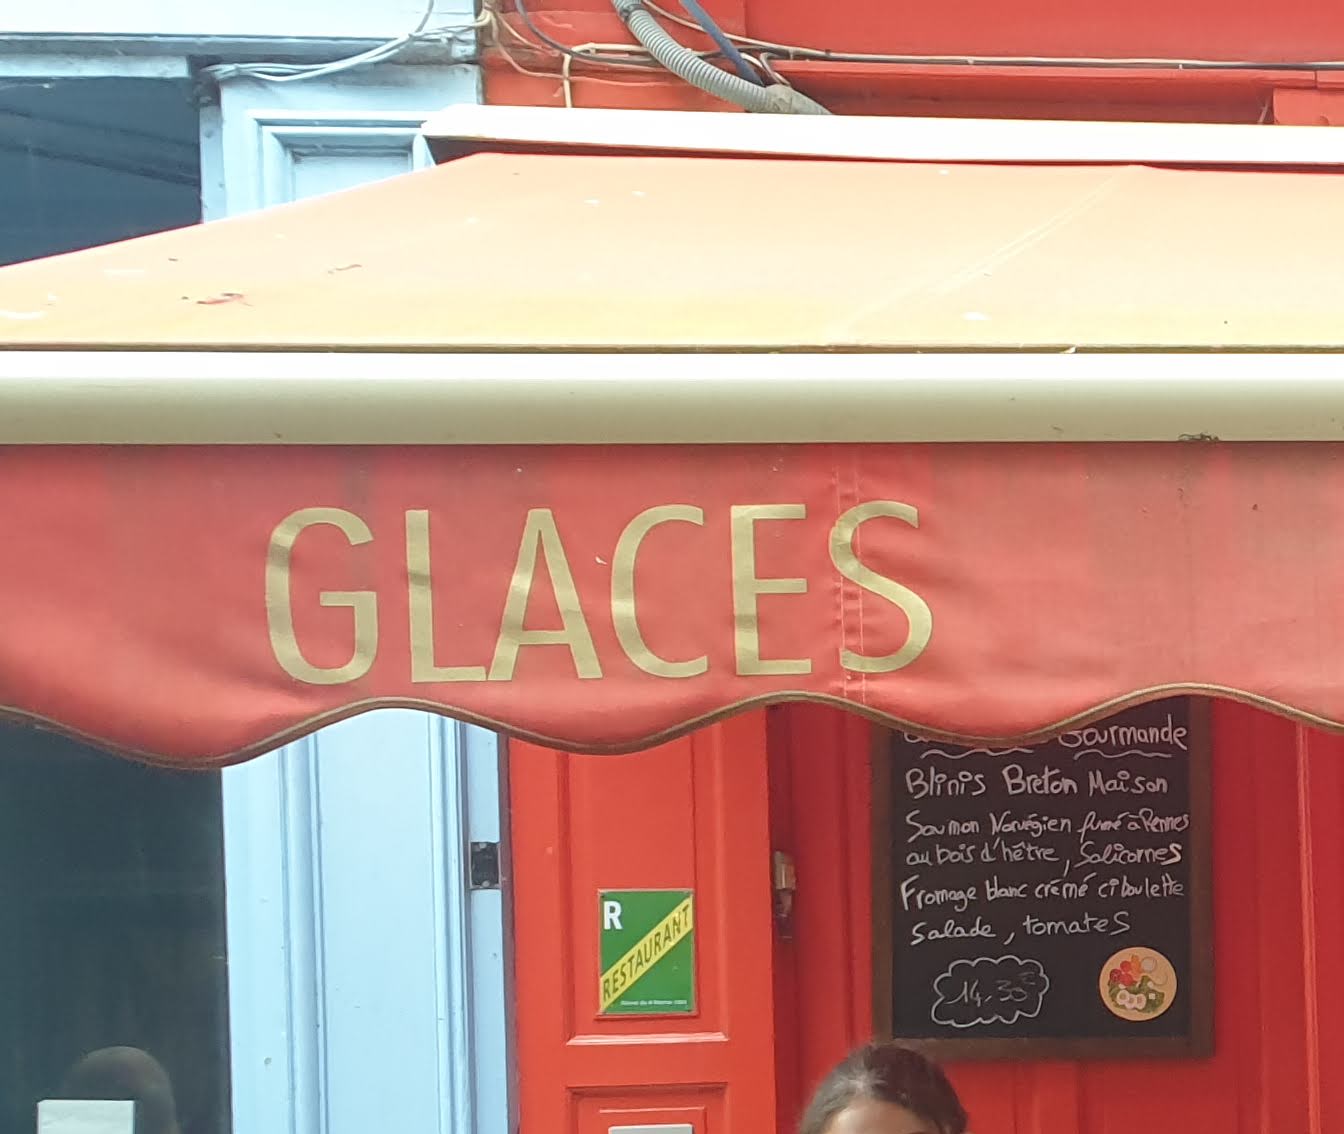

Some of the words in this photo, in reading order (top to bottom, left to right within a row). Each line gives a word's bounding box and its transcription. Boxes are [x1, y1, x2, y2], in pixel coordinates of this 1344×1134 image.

[264, 501, 933, 685] GLACES
[905, 765, 987, 799] Blinis
[1001, 764, 1078, 796] Breton
[1088, 768, 1169, 798] Maison
[906, 849, 934, 866] au
[935, 843, 974, 864] bois
[899, 875, 977, 912] Fromage
[984, 875, 1029, 901] blanc
[603, 901, 623, 930] R
[1021, 911, 1132, 937] tomates
[603, 904, 689, 1002] RESTAURANT
